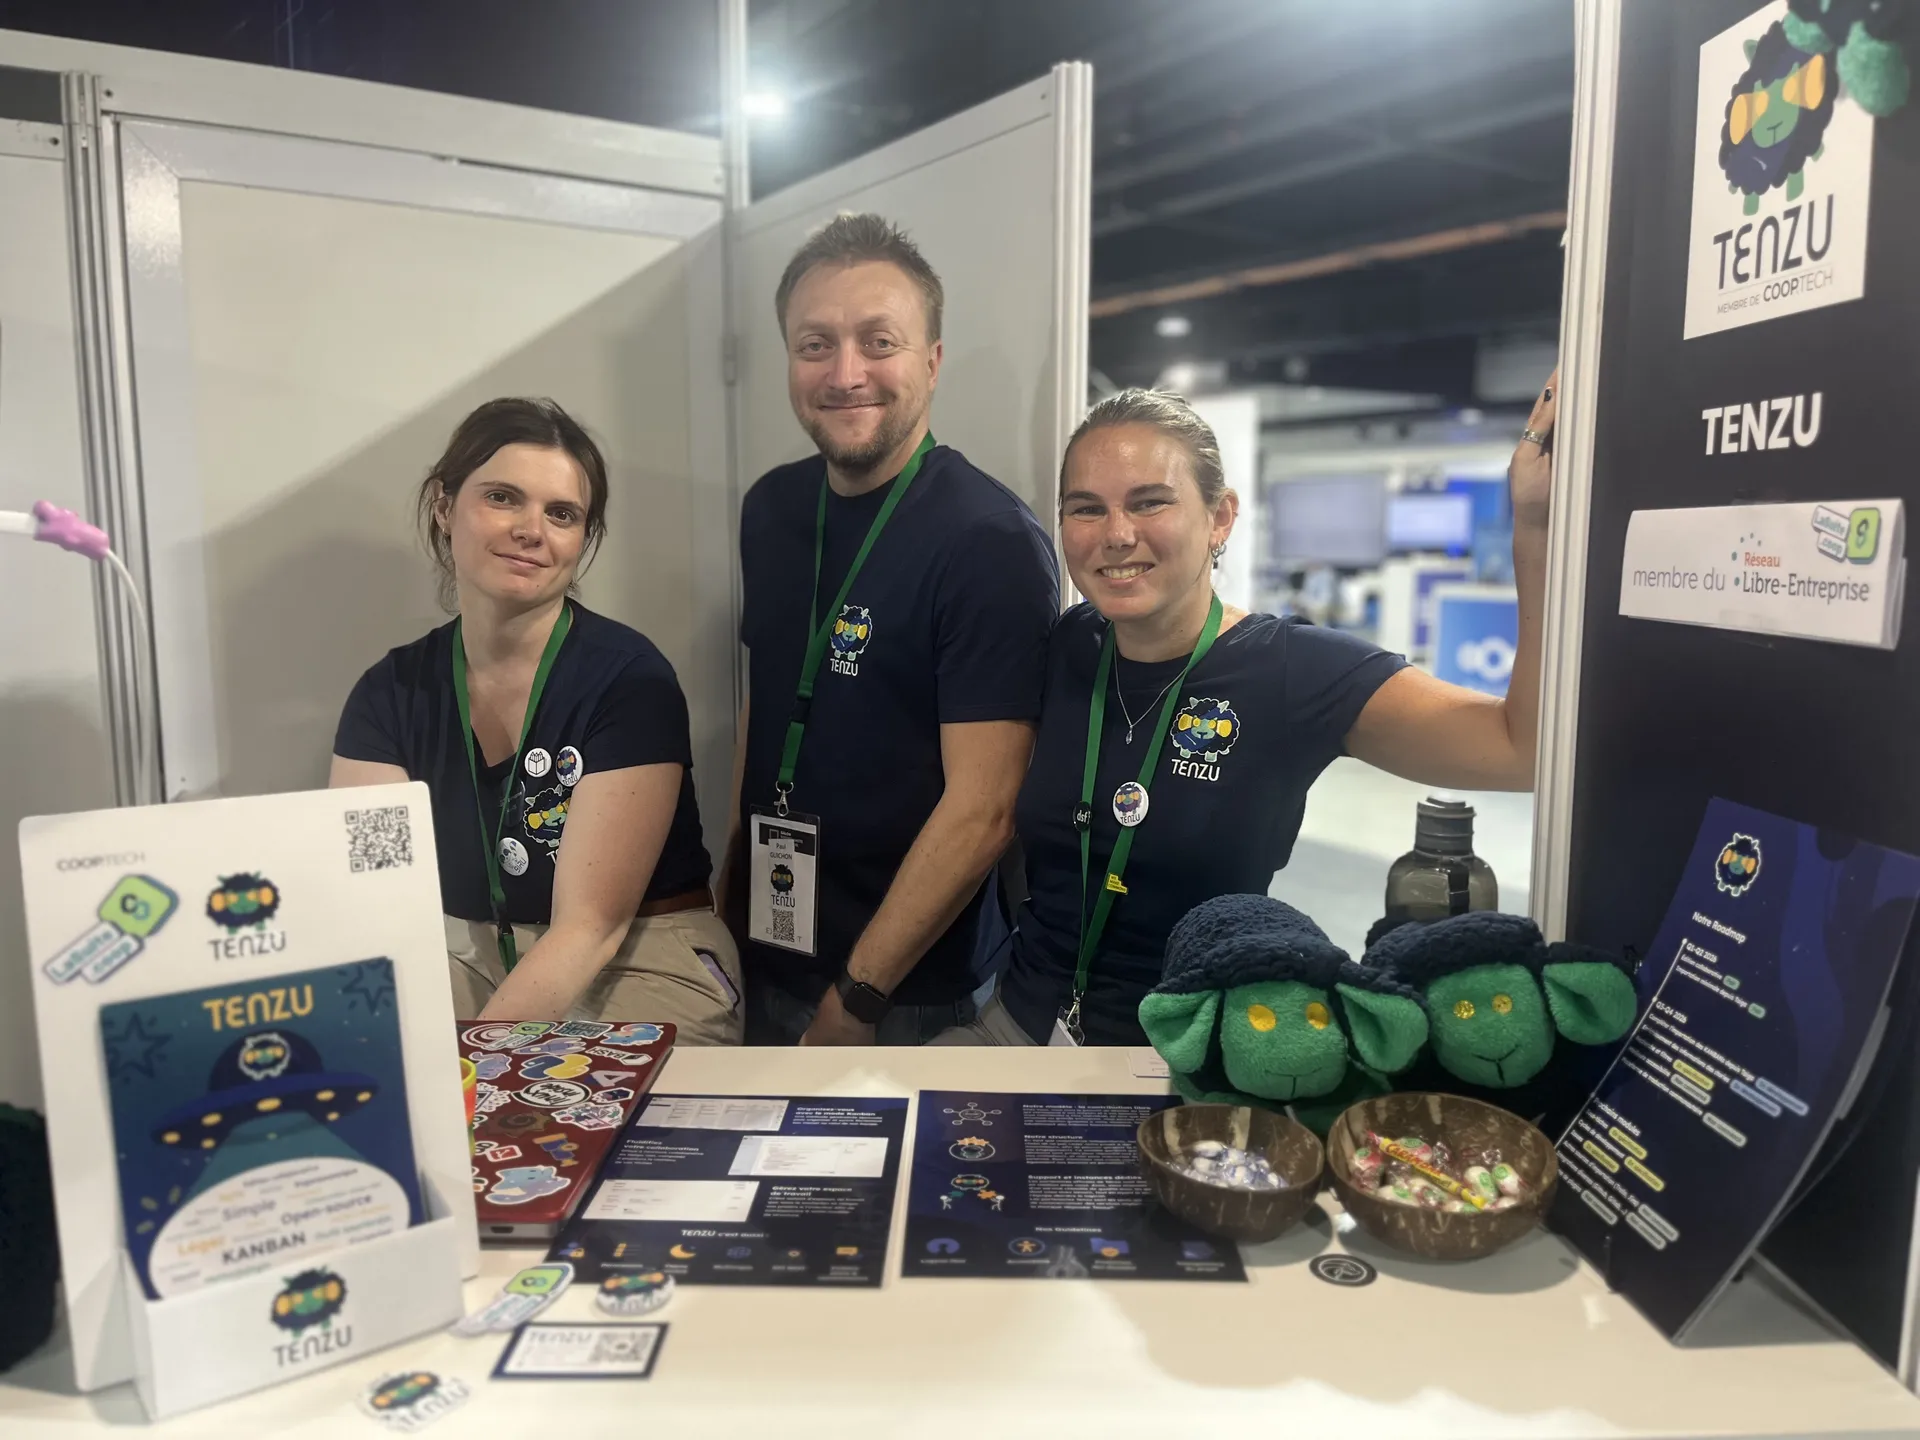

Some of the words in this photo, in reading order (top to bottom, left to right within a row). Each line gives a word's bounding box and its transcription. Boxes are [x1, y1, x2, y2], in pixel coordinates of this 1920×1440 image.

[1713, 193, 1834, 290] TENZU
[1716, 296, 1748, 314] MEMBRE
[1749, 294, 1760, 306] DE
[1702, 392, 1823, 456] TENZU
[1744, 552, 1781, 568] Réseau
[1633, 565, 1698, 590] membre
[1703, 567, 1726, 591] du
[1742, 571, 1870, 605] Libre-Entreprise
[830, 658, 859, 677] TENZU
[1171, 758, 1221, 782] TENZU
[1120, 813, 1140, 824] TENZU
[57, 852, 145, 871] COOPTECH
[771, 894, 795, 908] TENZU
[1692, 911, 1712, 926] Notre
[1710, 920, 1746, 945] Roadmap
[208, 930, 286, 961] TENZU
[203, 984, 314, 1031] TENZU
[591, 1047, 626, 1060] BASH
[222, 1199, 277, 1222] Simple
[281, 1194, 373, 1226] Open-source
[680, 1228, 716, 1238] TENZU
[222, 1232, 306, 1265] KANBAN
[272, 1327, 352, 1367] TENZU
